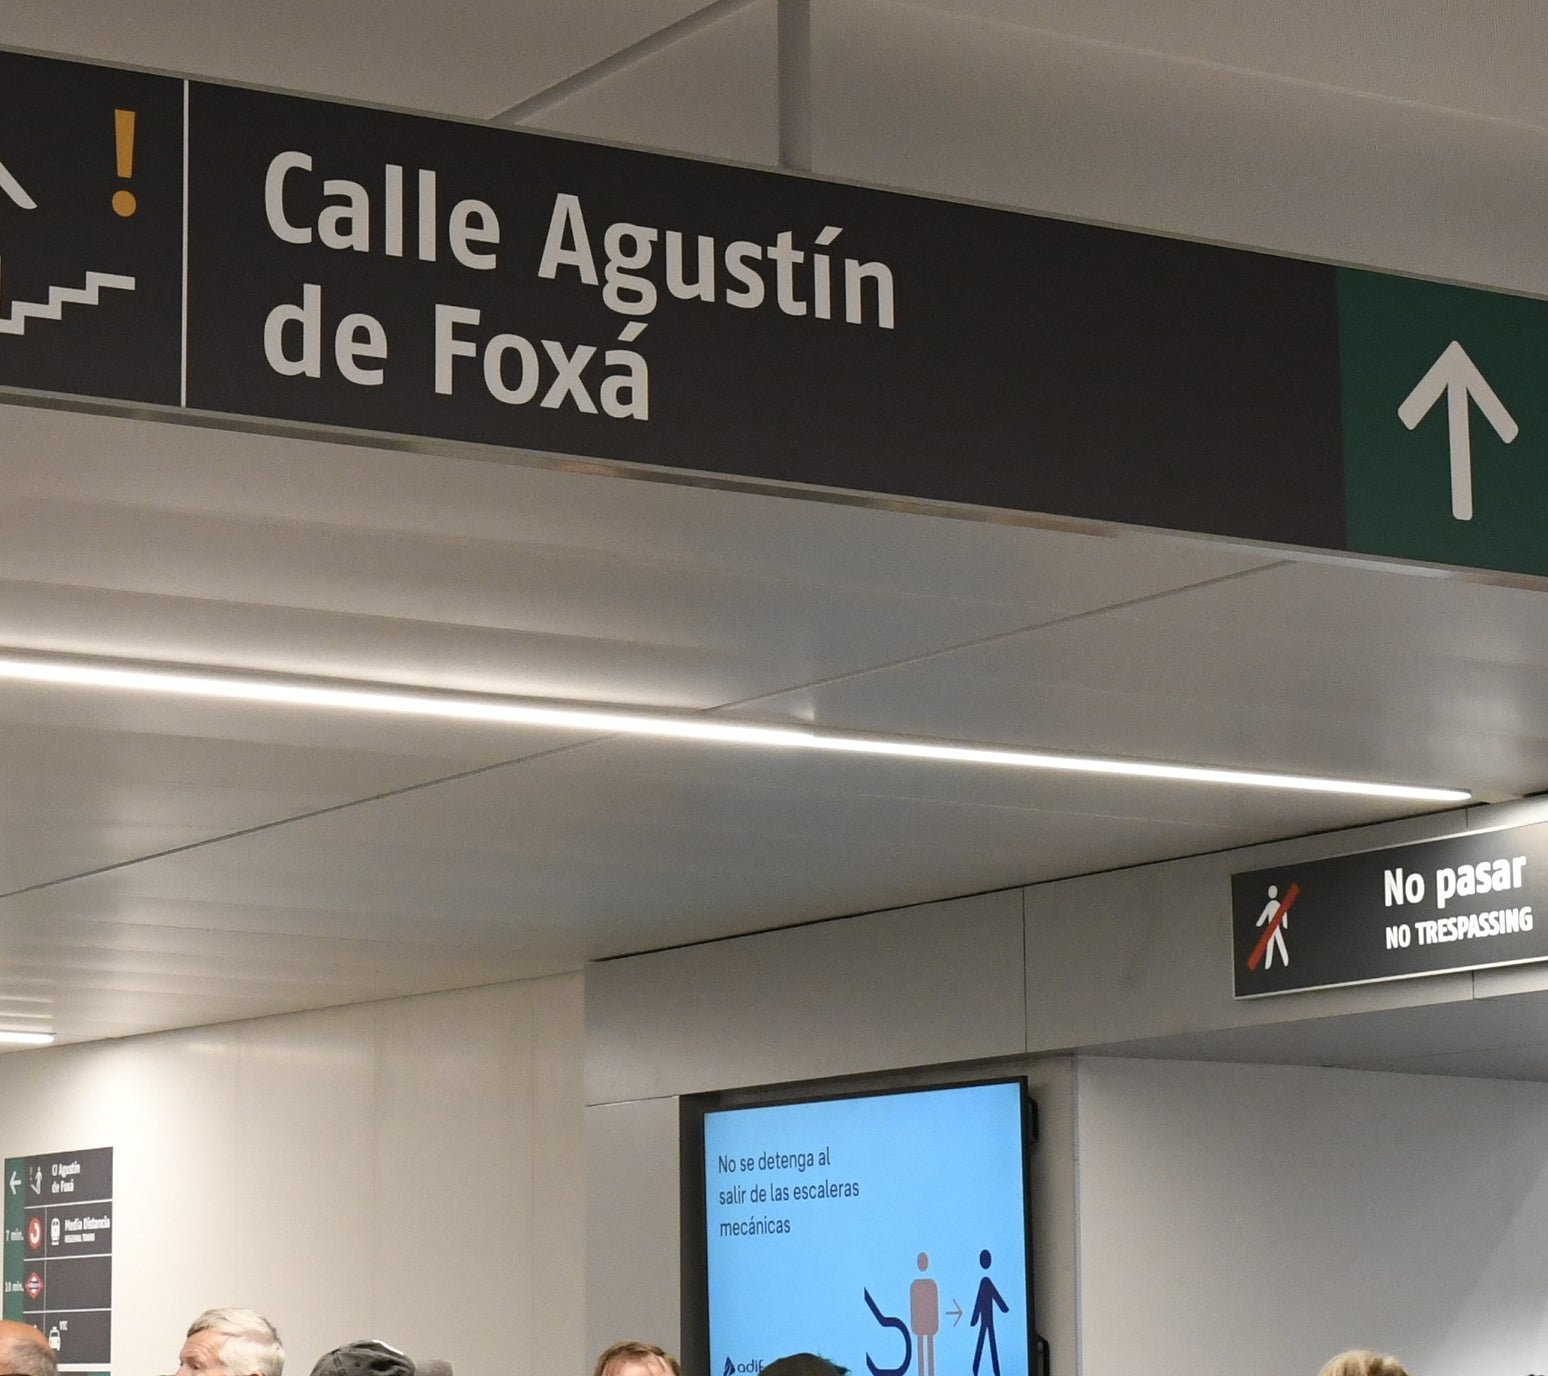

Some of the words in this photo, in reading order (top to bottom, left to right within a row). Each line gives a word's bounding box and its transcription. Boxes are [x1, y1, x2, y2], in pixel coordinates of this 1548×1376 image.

[263, 150, 501, 271] Calle
[537, 192, 896, 330] Agustín
[262, 283, 388, 386] de
[434, 303, 650, 422] Foxá
[1384, 866, 1425, 908] No
[1436, 856, 1527, 909] pasar
[1386, 925, 1411, 949] NO
[1415, 906, 1534, 946] TRESPASSING
[718, 1154, 737, 1174] No
[740, 1157, 754, 1172] se
[758, 1149, 814, 1173] detenga
[818, 1145, 831, 1167] al
[718, 1184, 746, 1205] salir
[750, 1182, 767, 1203] de
[770, 1181, 789, 1202] las
[793, 1178, 860, 1200] escaleras
[720, 1215, 791, 1237] mecánicas
[737, 1358, 764, 1373] adif
